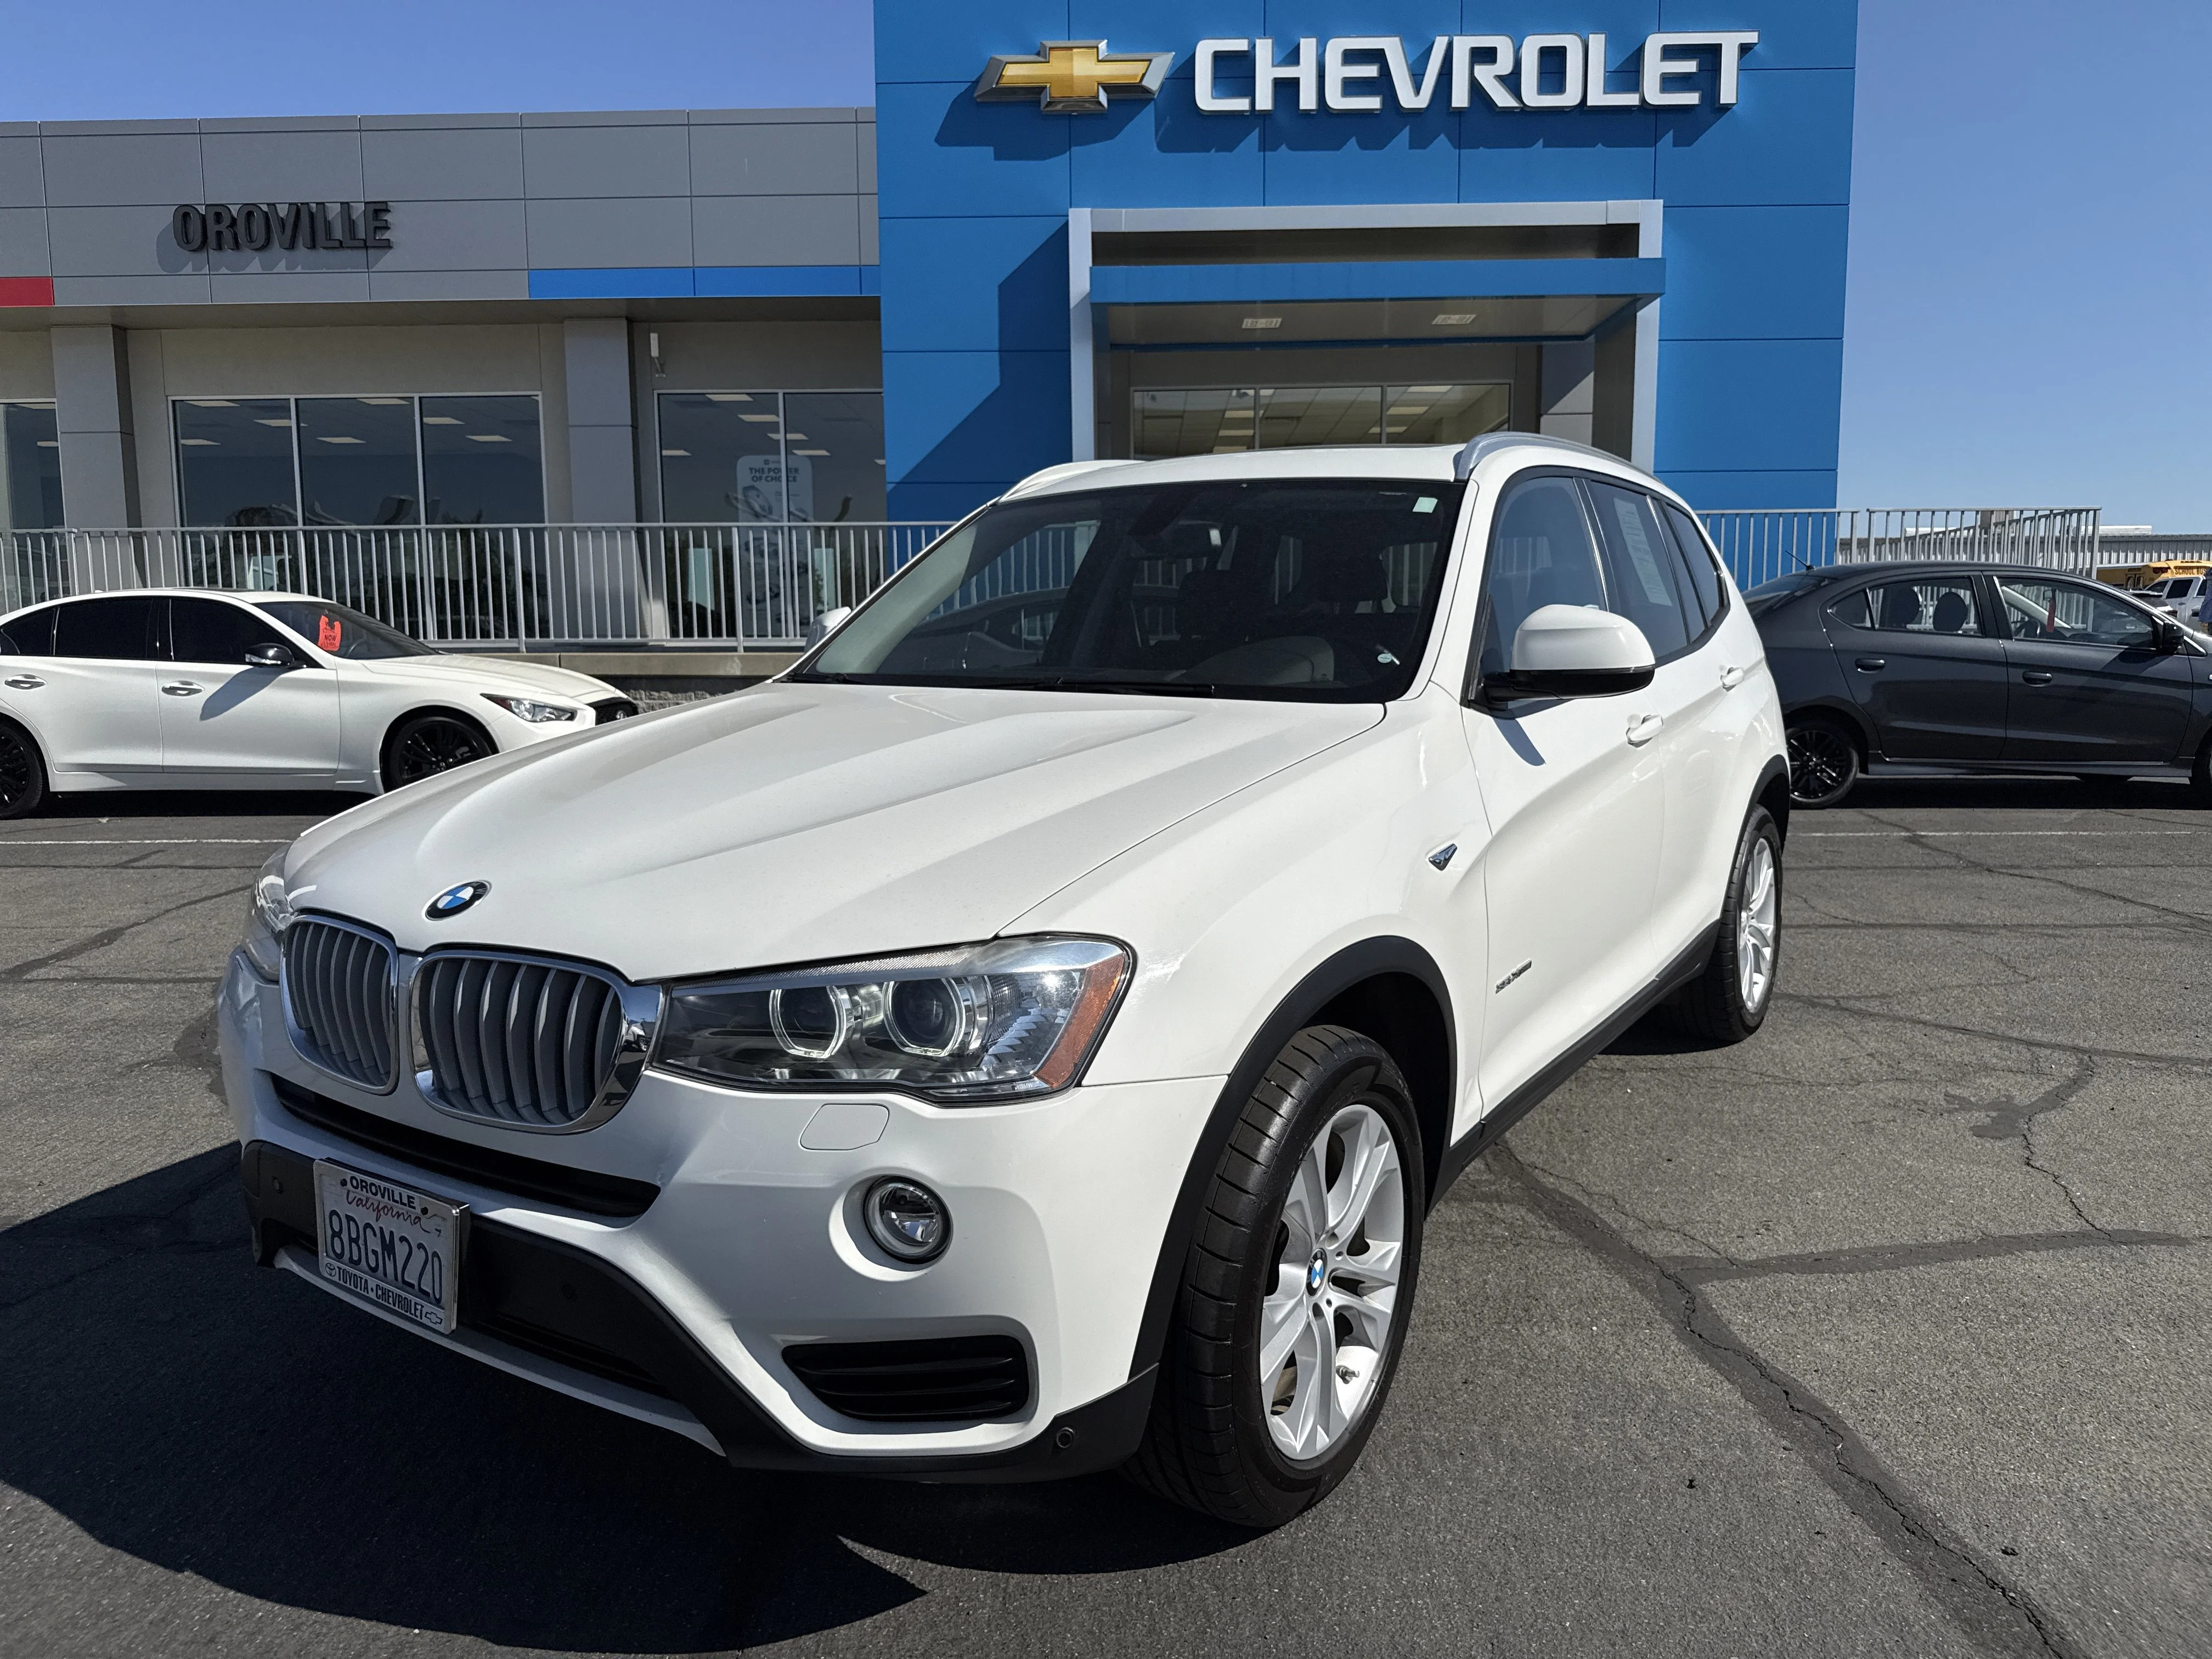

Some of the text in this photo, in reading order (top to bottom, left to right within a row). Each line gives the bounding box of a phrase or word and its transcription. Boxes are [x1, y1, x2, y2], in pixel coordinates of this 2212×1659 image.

[1194, 30, 1760, 112] CHEVROLET
[173, 201, 393, 252] OROVILLE
[2175, 566, 2195, 575] SCHOOL
[350, 1176, 416, 1210] OROVILLE
[329, 1209, 442, 1304] 8BGM220
[337, 1266, 425, 1320] TOYOTA CHEVROLET
